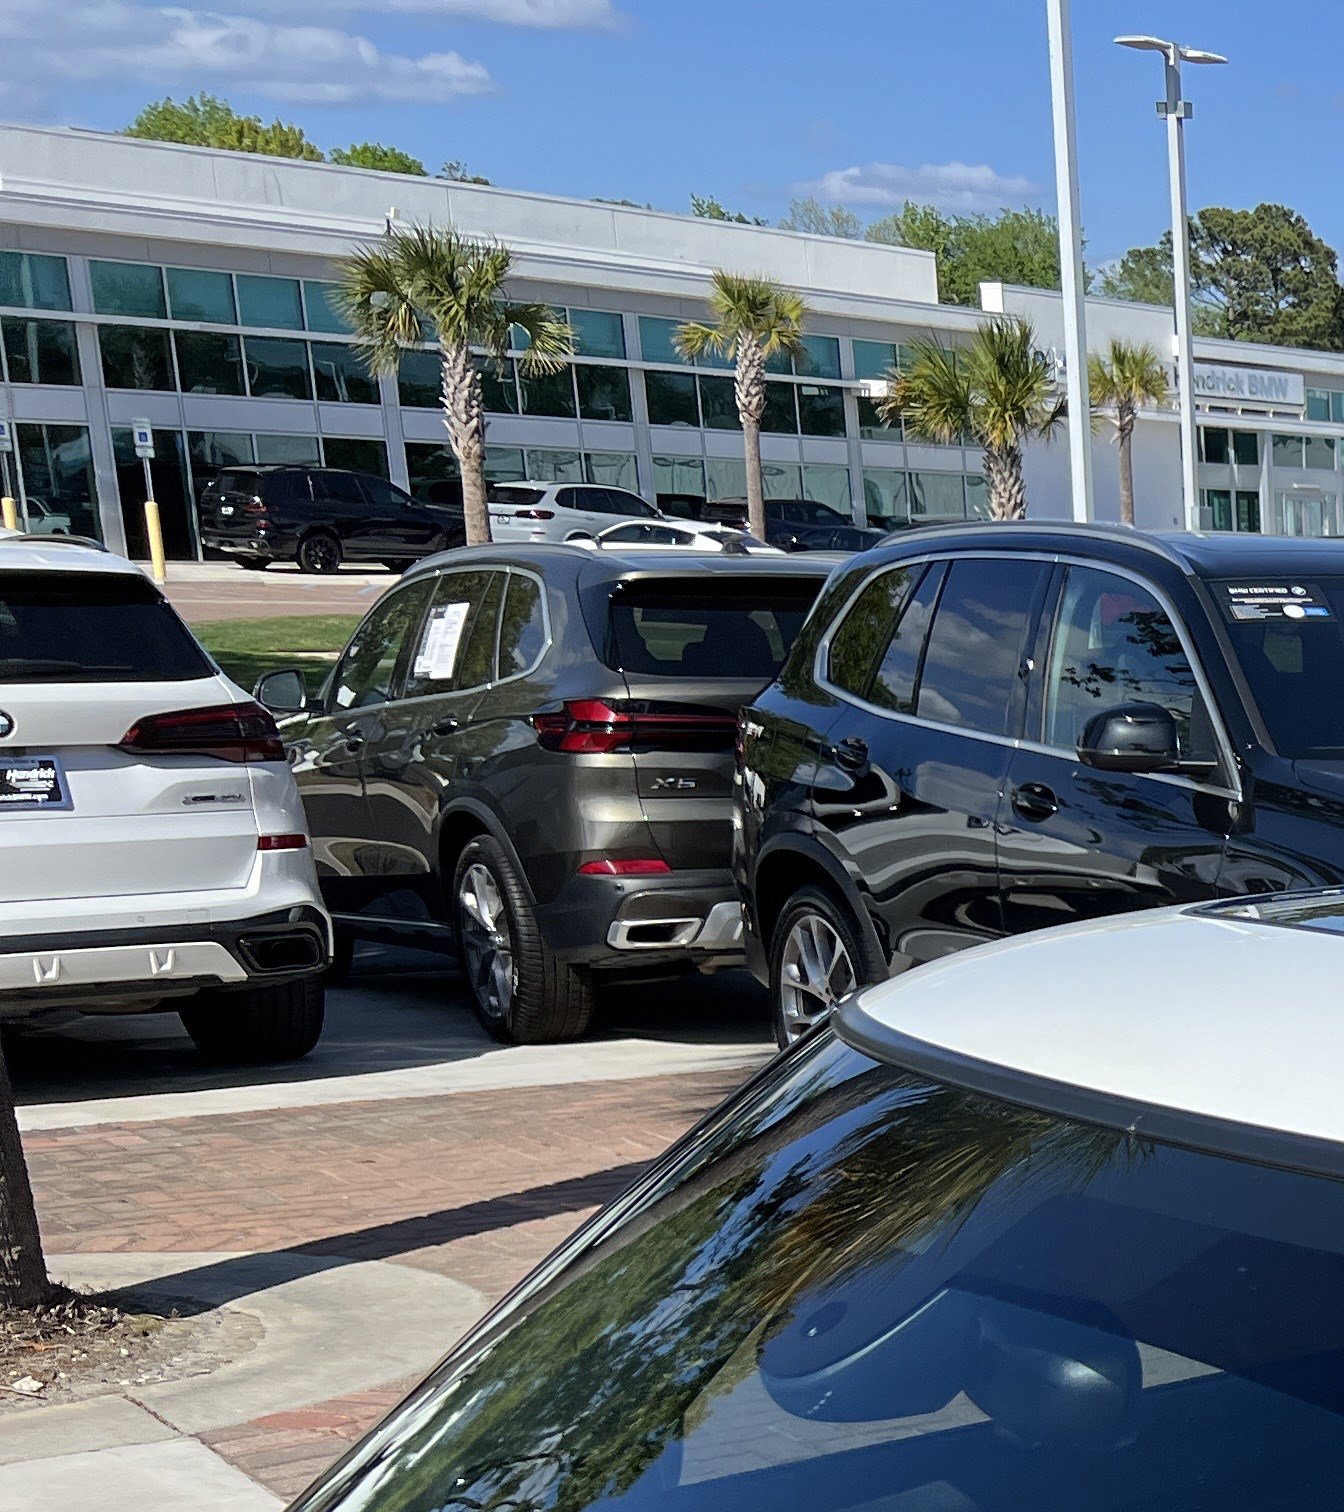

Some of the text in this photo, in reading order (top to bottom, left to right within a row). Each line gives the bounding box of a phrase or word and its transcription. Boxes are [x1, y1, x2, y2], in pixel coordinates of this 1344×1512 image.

[1174, 366, 1288, 400] ndrick BMW
[650, 777, 697, 789] X5
